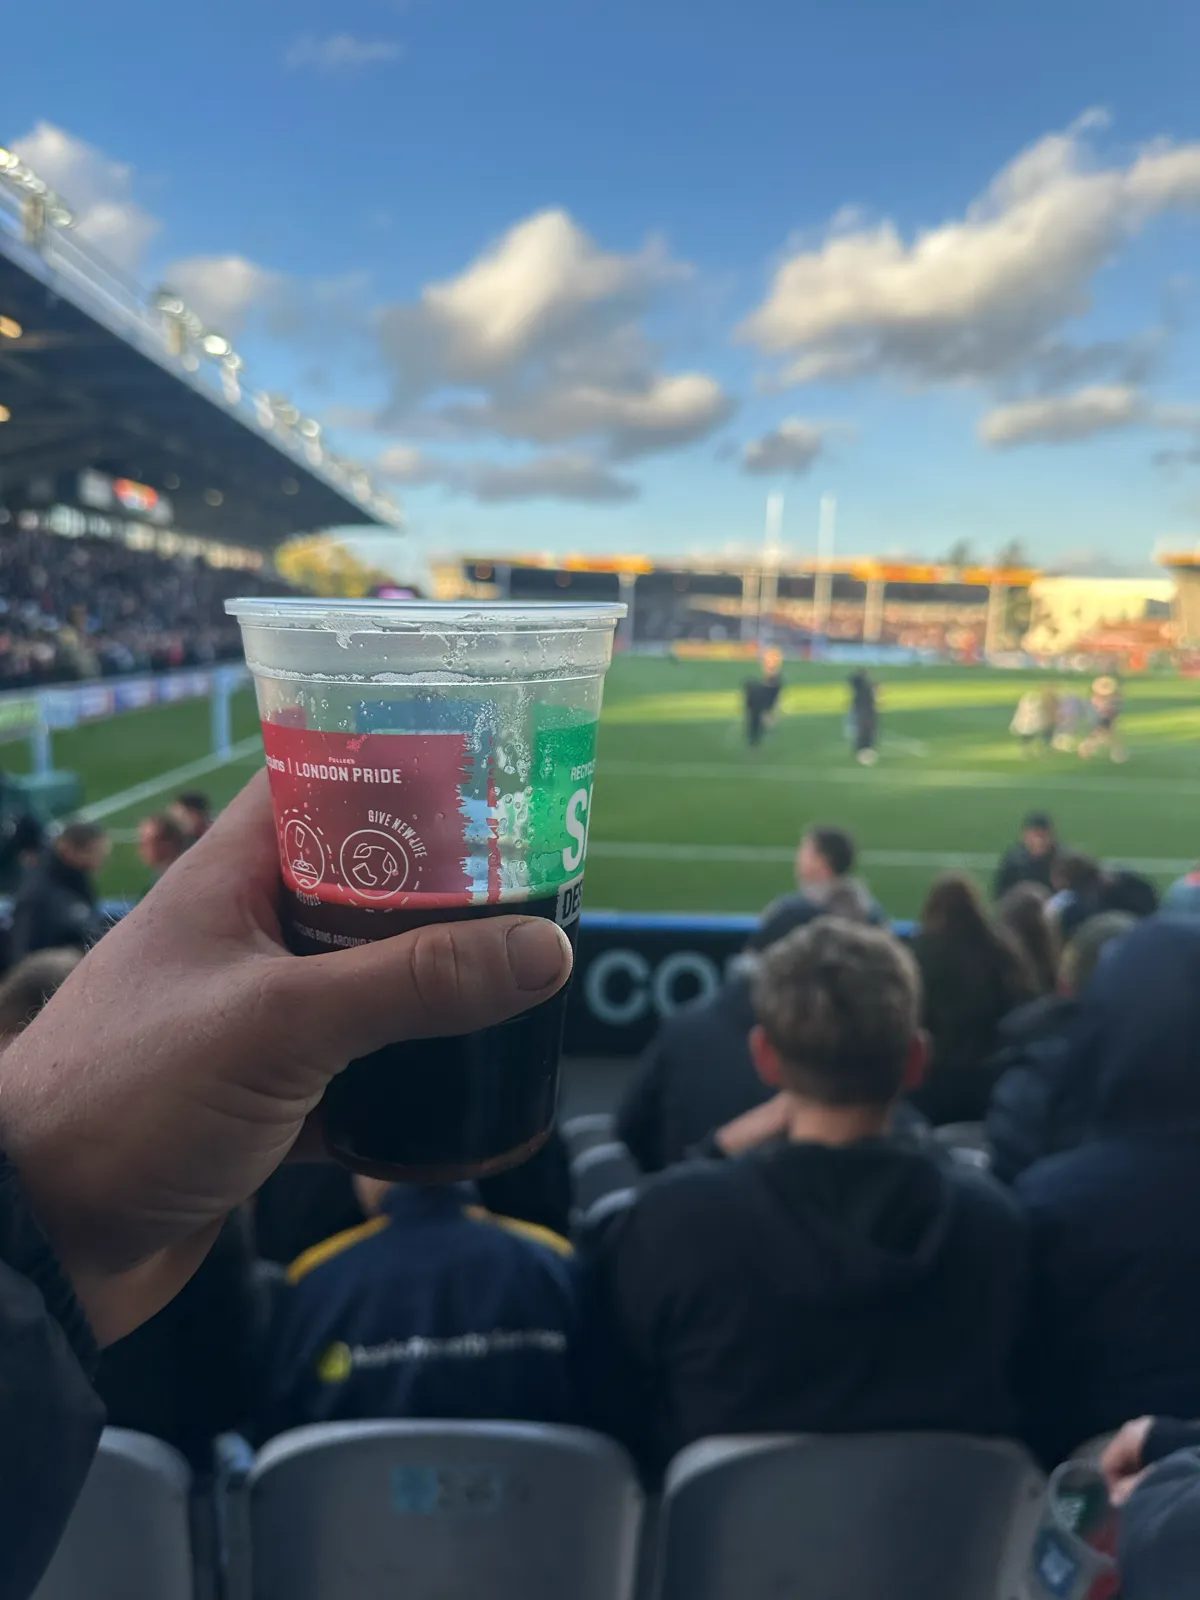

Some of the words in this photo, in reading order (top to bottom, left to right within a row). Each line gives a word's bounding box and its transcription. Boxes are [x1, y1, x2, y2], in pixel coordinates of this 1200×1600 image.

[295, 761, 349, 782] LONDON
[352, 767, 402, 784] PRIDE
[368, 809, 392, 827] GIVE
[391, 818, 417, 840] NEW
